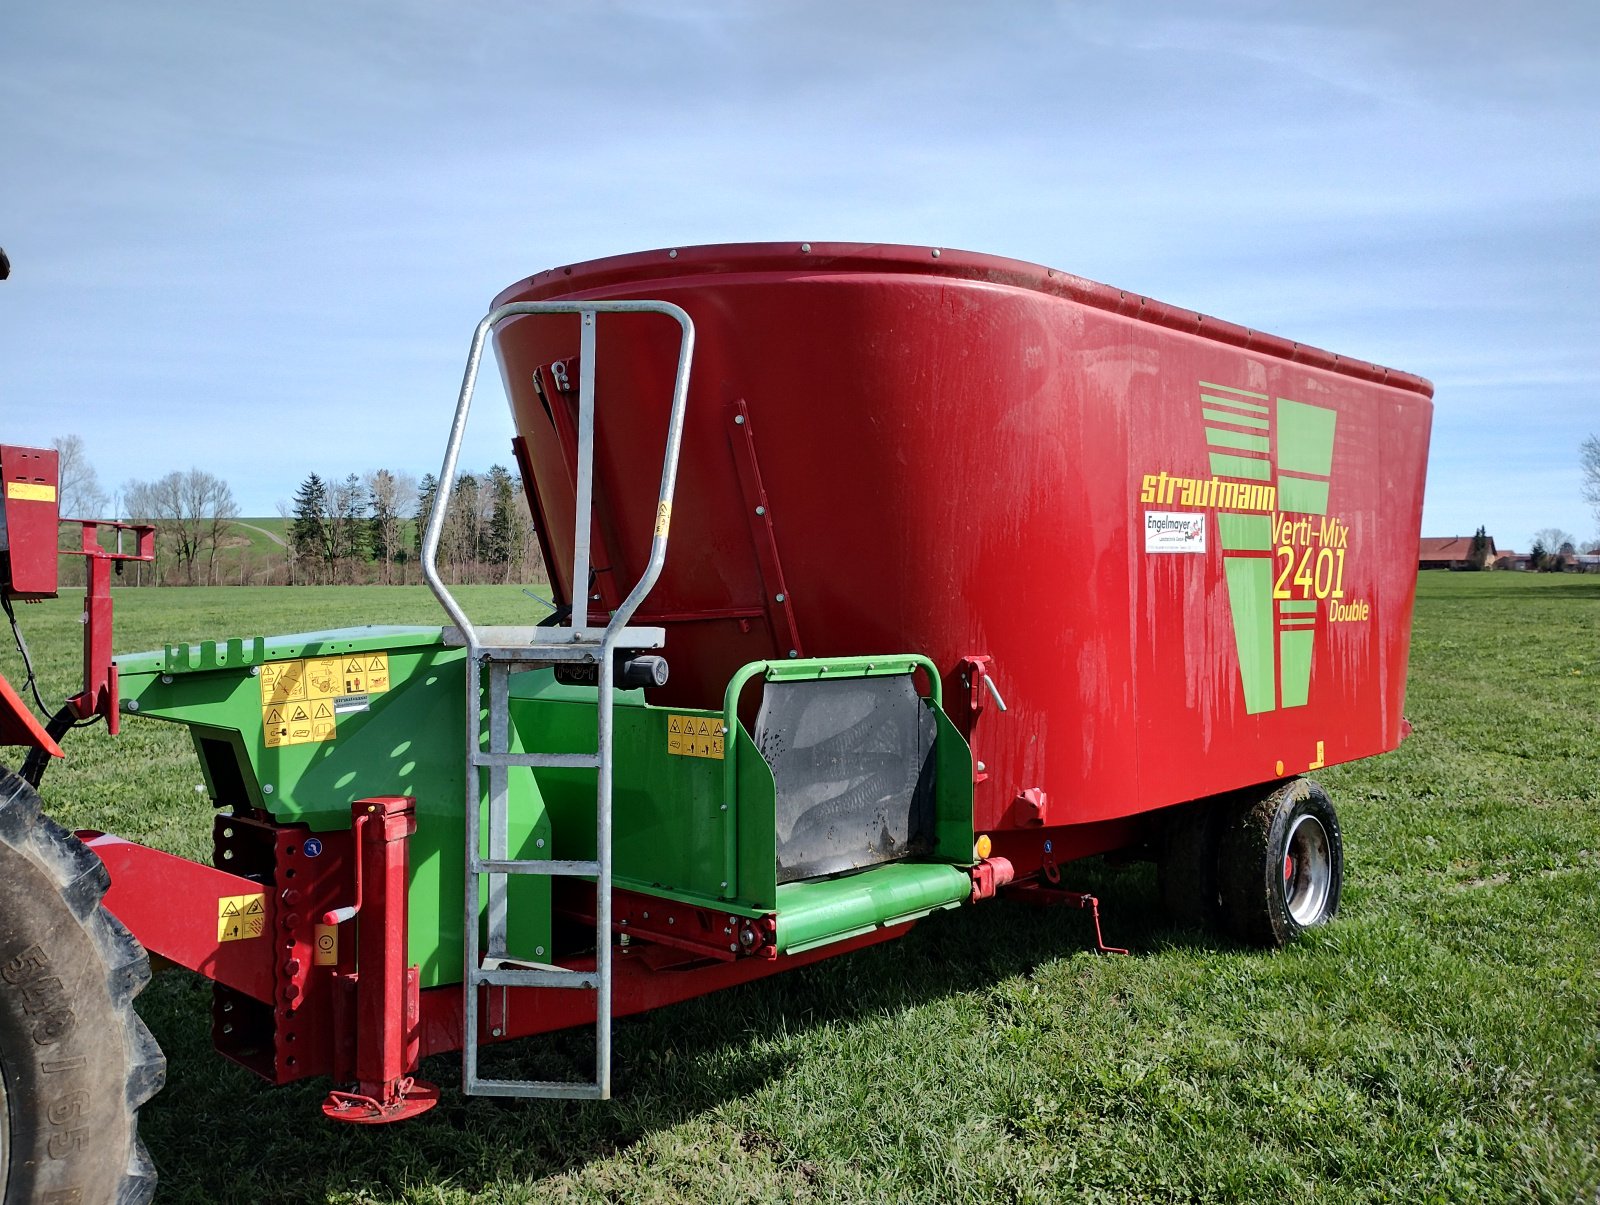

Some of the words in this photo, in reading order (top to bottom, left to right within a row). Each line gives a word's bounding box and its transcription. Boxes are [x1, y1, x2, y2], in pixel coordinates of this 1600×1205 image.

[1140, 471, 1276, 511] strautmann
[1147, 514, 1191, 533] Engelmayer
[1271, 511, 1350, 548] Verti-Mix
[1273, 545, 1345, 599] 2401
[1329, 599, 1369, 623] Double
